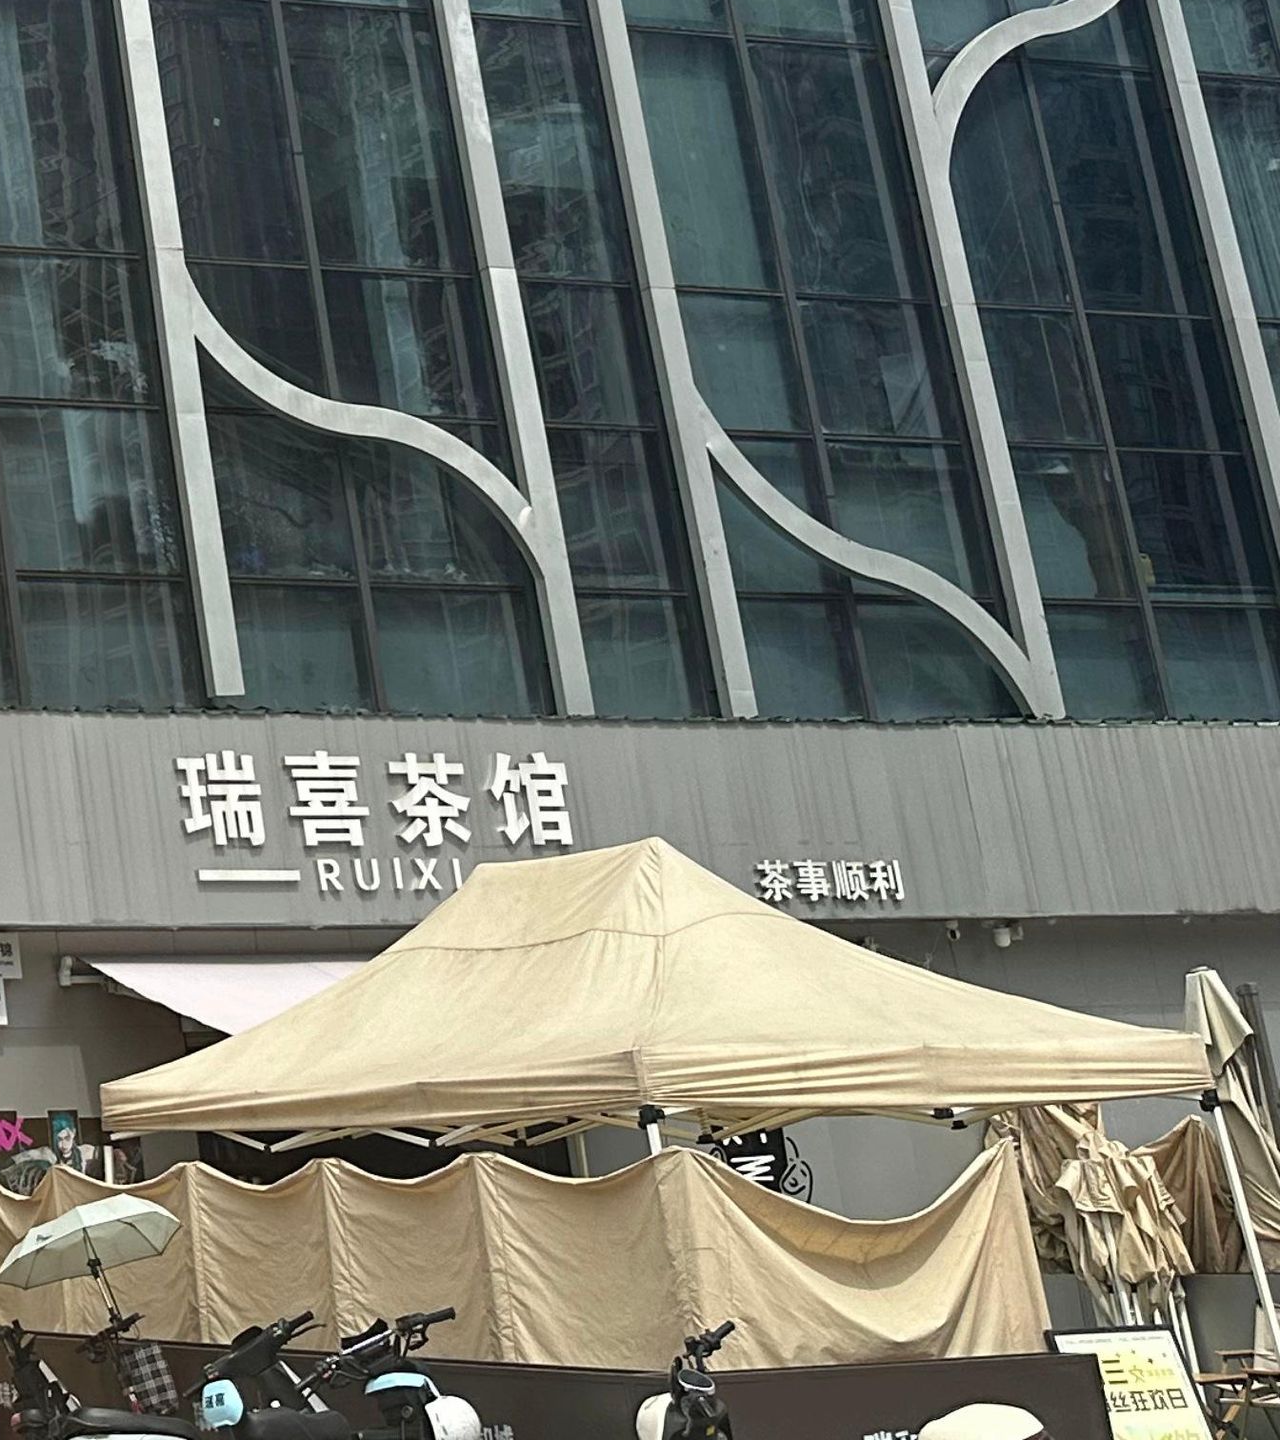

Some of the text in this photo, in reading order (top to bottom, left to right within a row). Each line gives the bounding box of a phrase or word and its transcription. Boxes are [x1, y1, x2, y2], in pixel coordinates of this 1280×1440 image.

[176, 750, 573, 847] 瑞喜茶馆
[318, 857, 464, 891] RUIXI
[755, 859, 905, 902] 茶事顺利
[1104, 1388, 1189, 1413] 丝狂欢日
